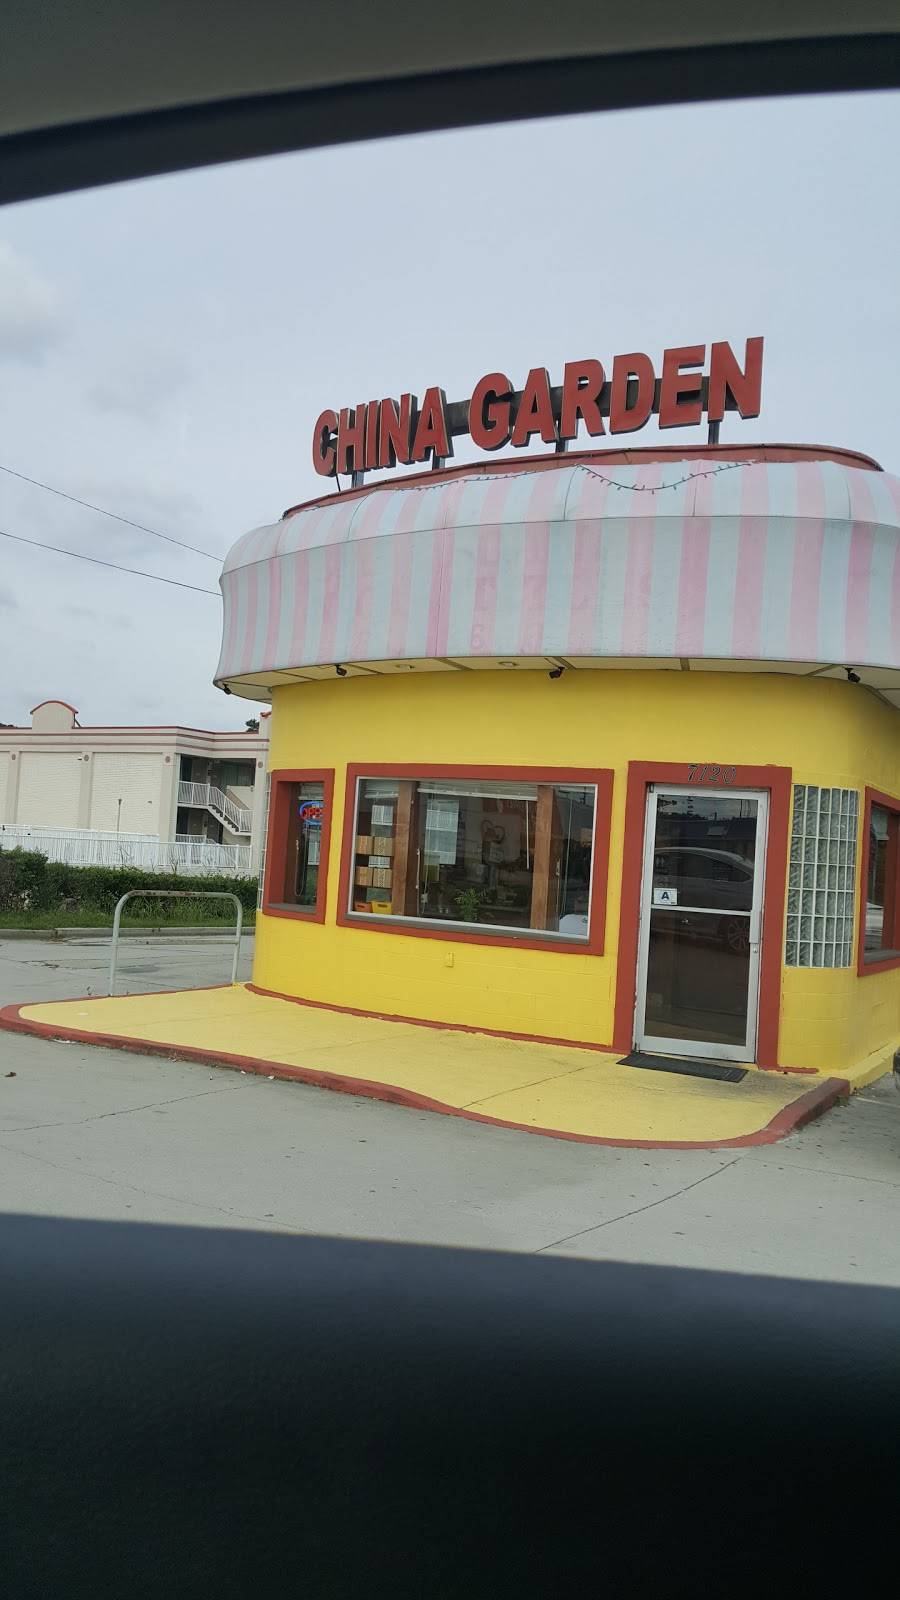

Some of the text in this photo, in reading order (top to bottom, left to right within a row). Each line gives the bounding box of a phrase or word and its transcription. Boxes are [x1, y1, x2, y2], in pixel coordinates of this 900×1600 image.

[312, 336, 765, 477] CHINA GARDEN
[688, 764, 736, 785] 7120
[661, 891, 670, 900] A
